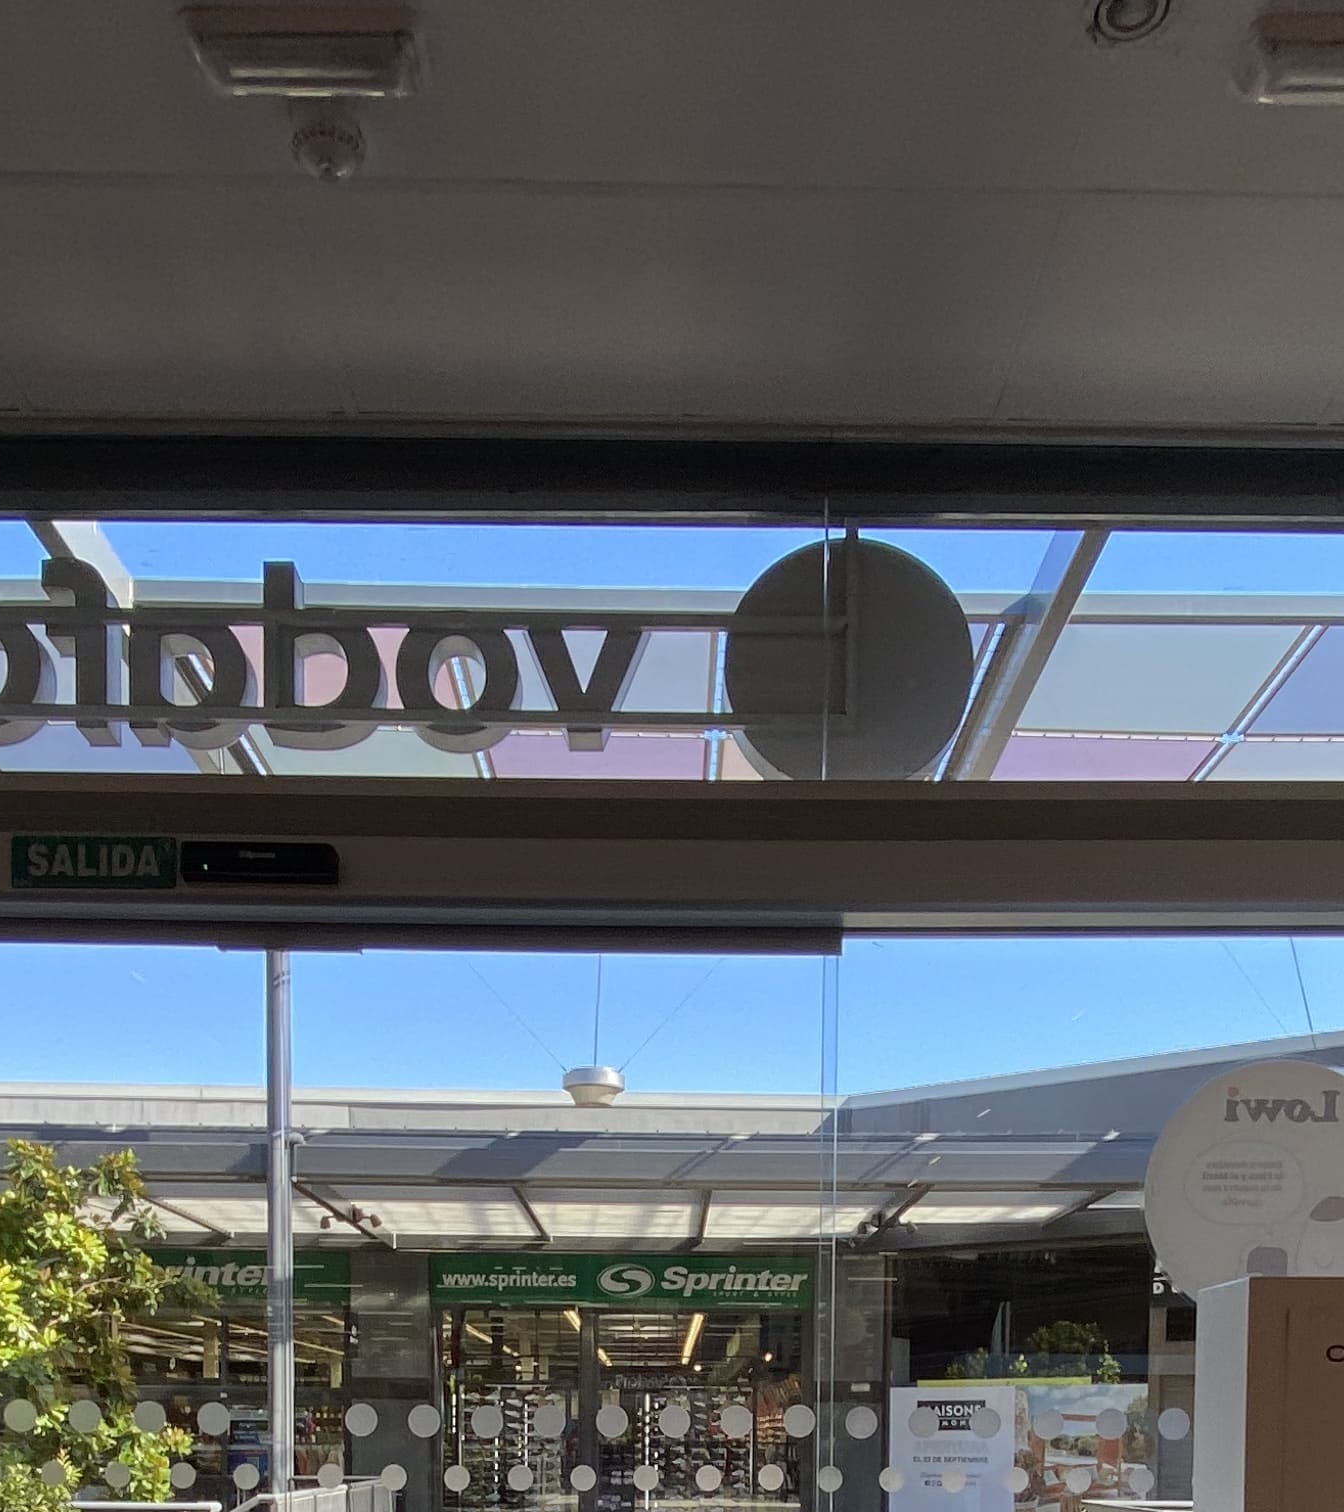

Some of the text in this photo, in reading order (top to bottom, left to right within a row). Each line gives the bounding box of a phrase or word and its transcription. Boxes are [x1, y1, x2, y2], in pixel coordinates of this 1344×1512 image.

[27, 844, 161, 877] SALIDA
[442, 1265, 808, 1297] www.sprinter.es Sprinter
